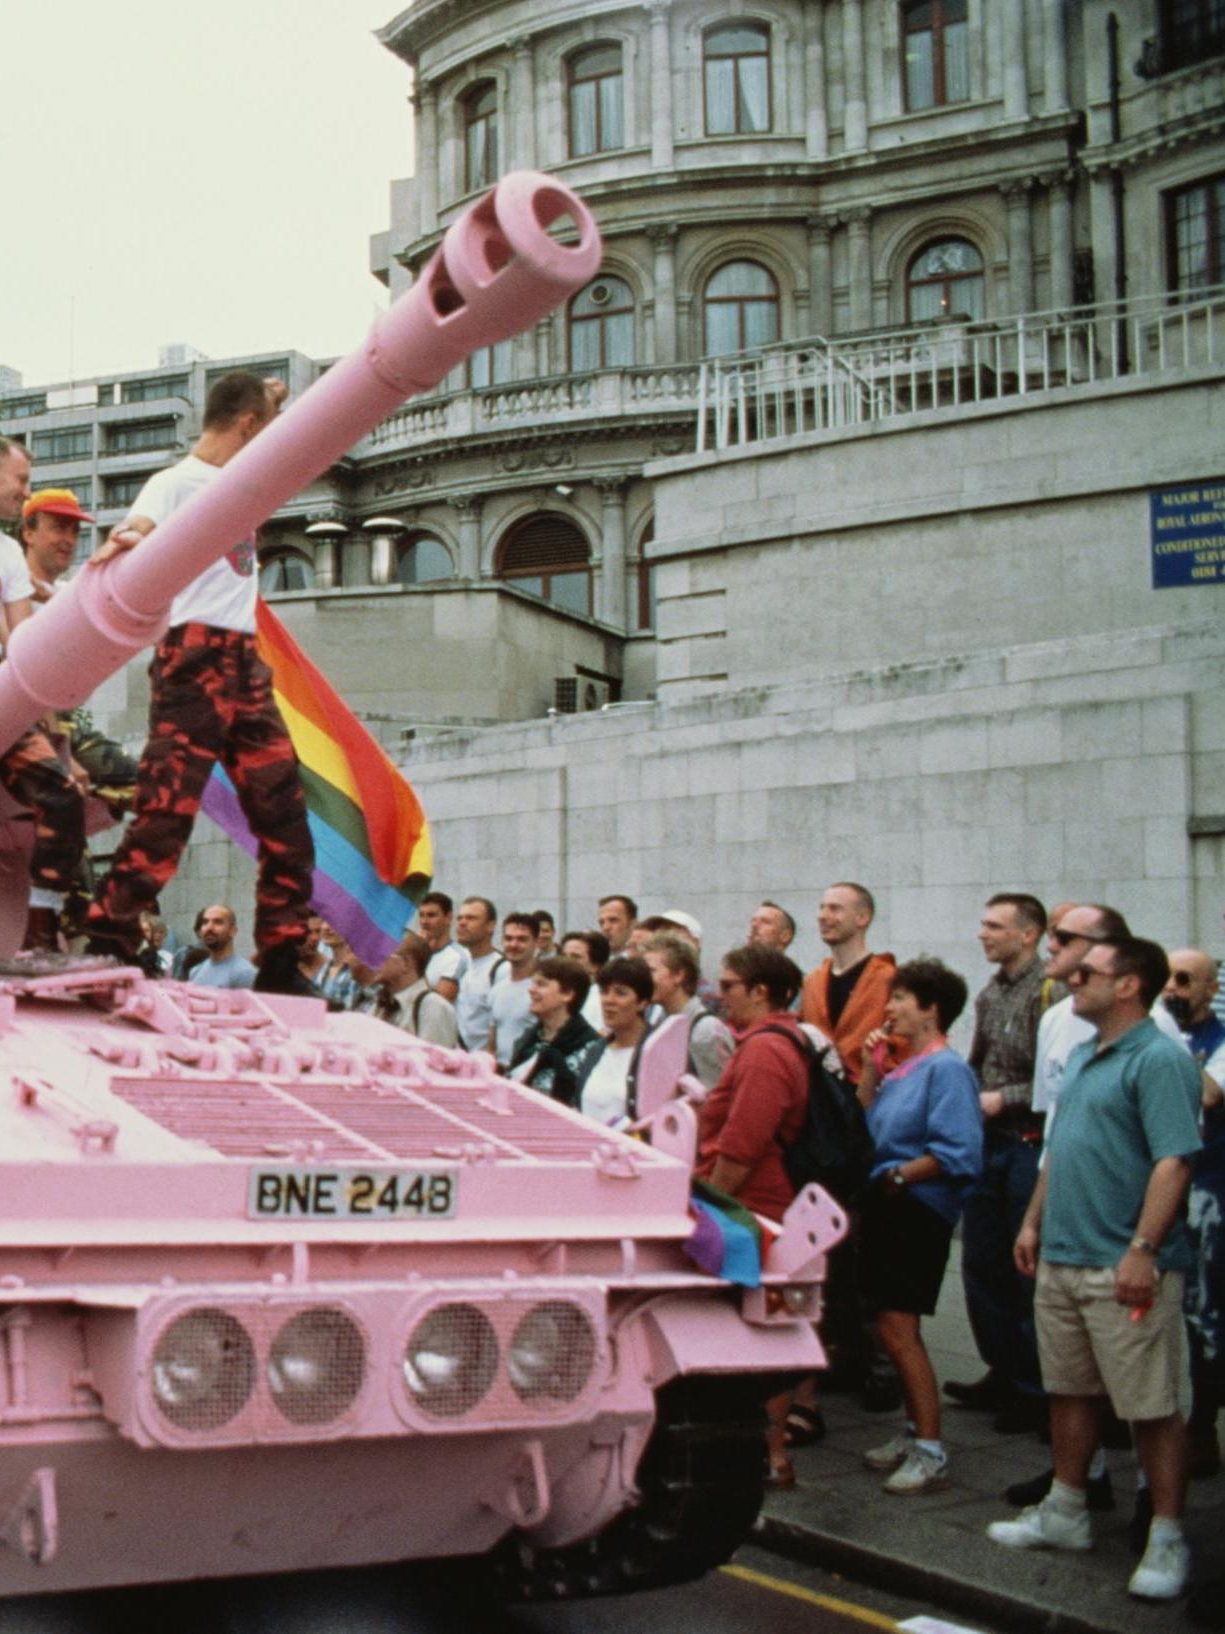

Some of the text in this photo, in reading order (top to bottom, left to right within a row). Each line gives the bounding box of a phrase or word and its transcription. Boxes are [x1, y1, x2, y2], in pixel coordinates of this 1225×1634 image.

[1161, 491, 1200, 506] MAJOR
[1157, 515, 1186, 529] ROYAL
[257, 1174, 452, 1214] BNE 244B
